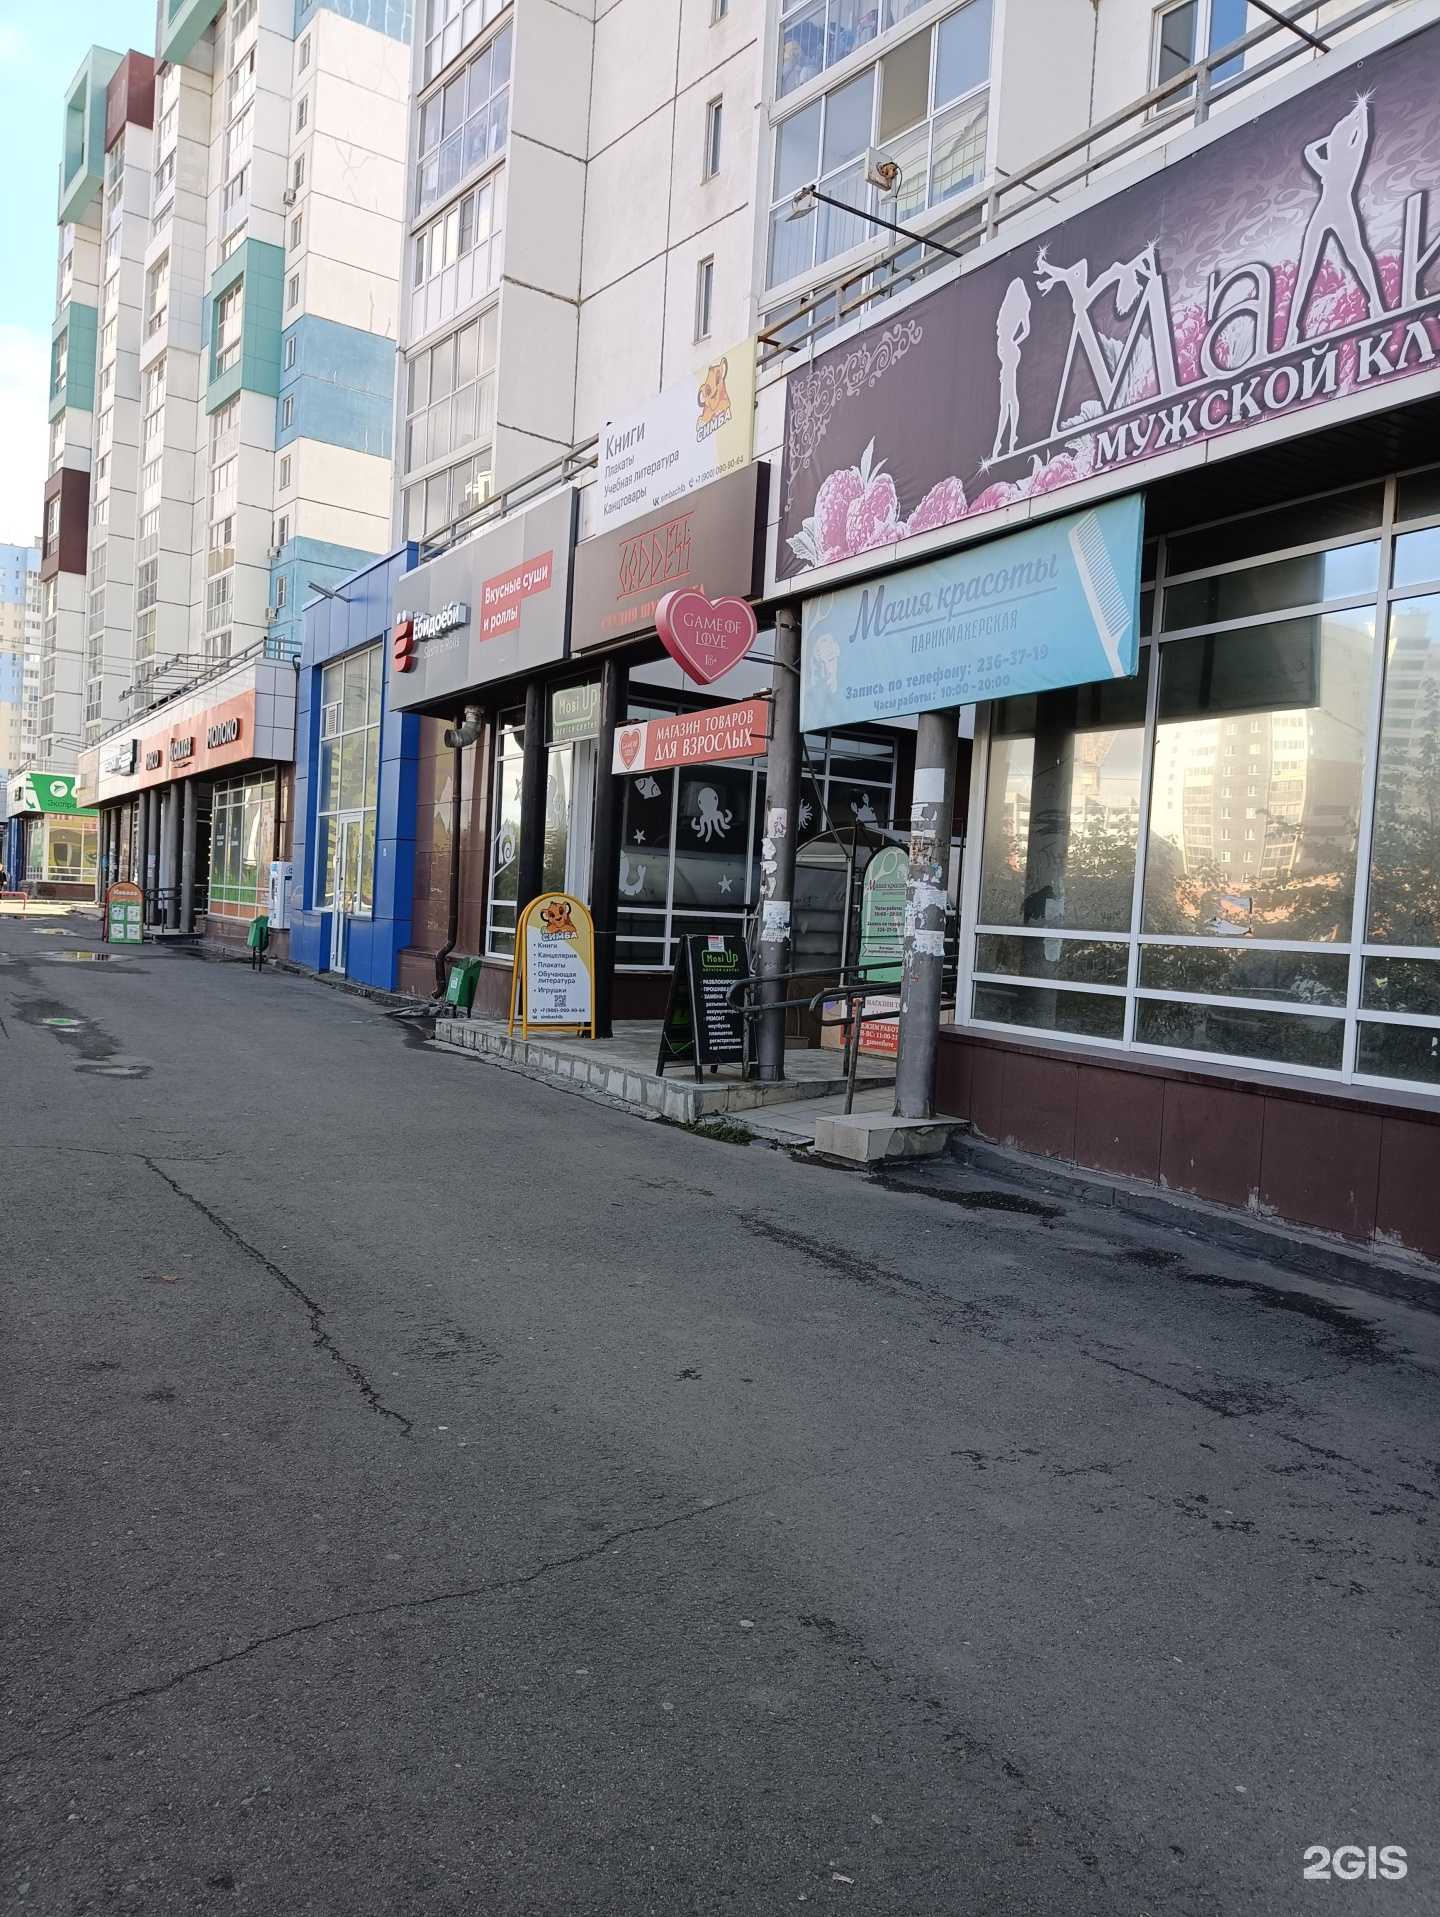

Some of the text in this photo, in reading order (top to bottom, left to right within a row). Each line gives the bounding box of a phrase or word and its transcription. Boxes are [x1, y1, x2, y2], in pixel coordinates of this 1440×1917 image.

[1094, 319, 1436, 470] МУЖСКОЙ КЛ
[605, 422, 646, 460] Книги
[695, 407, 733, 443] СИМБА
[604, 455, 635, 479] Плакаты
[604, 448, 680, 498] Учебная литература
[603, 487, 648, 516] Канцтовары
[484, 564, 549, 605] Вкусные суши
[849, 554, 1059, 643] Магия красоты
[483, 606, 518, 632] и роллы
[683, 612, 743, 635] GAME OF
[911, 609, 1018, 654] ПАРИКМАХЕРСКАЯ
[695, 631, 729, 650] LOVE
[846, 644, 1049, 700] Запись по телефону: 236-37-19
[873, 693, 896, 712] Часы
[897, 689, 937, 711] работы:
[656, 709, 754, 741] МАГАЗИН ТОВАРОВ
[654, 740, 677, 761] ДЛЯ
[682, 727, 753, 757] ВЗРОСЛЫХ
[537, 971, 577, 979] Обучающая
[537, 987, 567, 995] Игрушки
